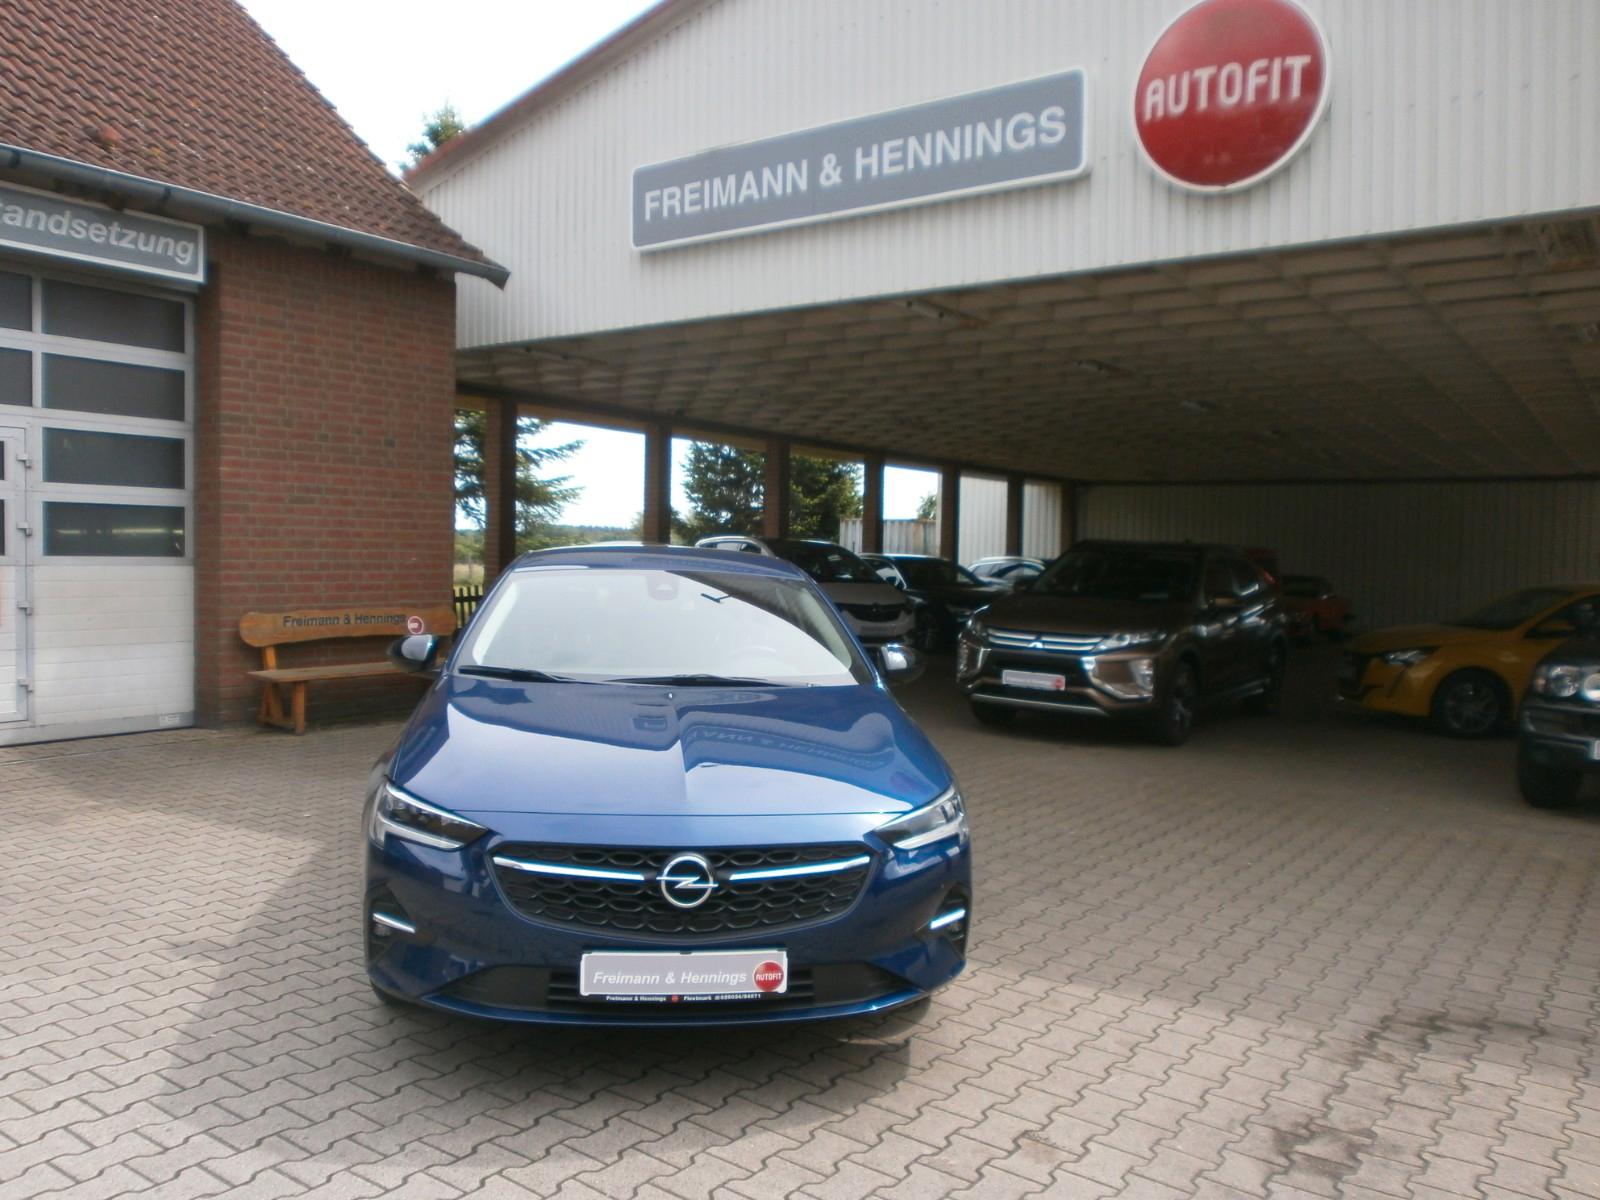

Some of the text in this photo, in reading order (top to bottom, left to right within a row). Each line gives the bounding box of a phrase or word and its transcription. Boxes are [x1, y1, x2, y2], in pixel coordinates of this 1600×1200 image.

[1144, 55, 1311, 122] AUTOFIT
[644, 106, 1067, 221] FREIMANN & HENNINGS
[283, 613, 407, 627] Freimann & Hennings
[593, 971, 782, 985] Freimann & Hennings AUTOFIT
